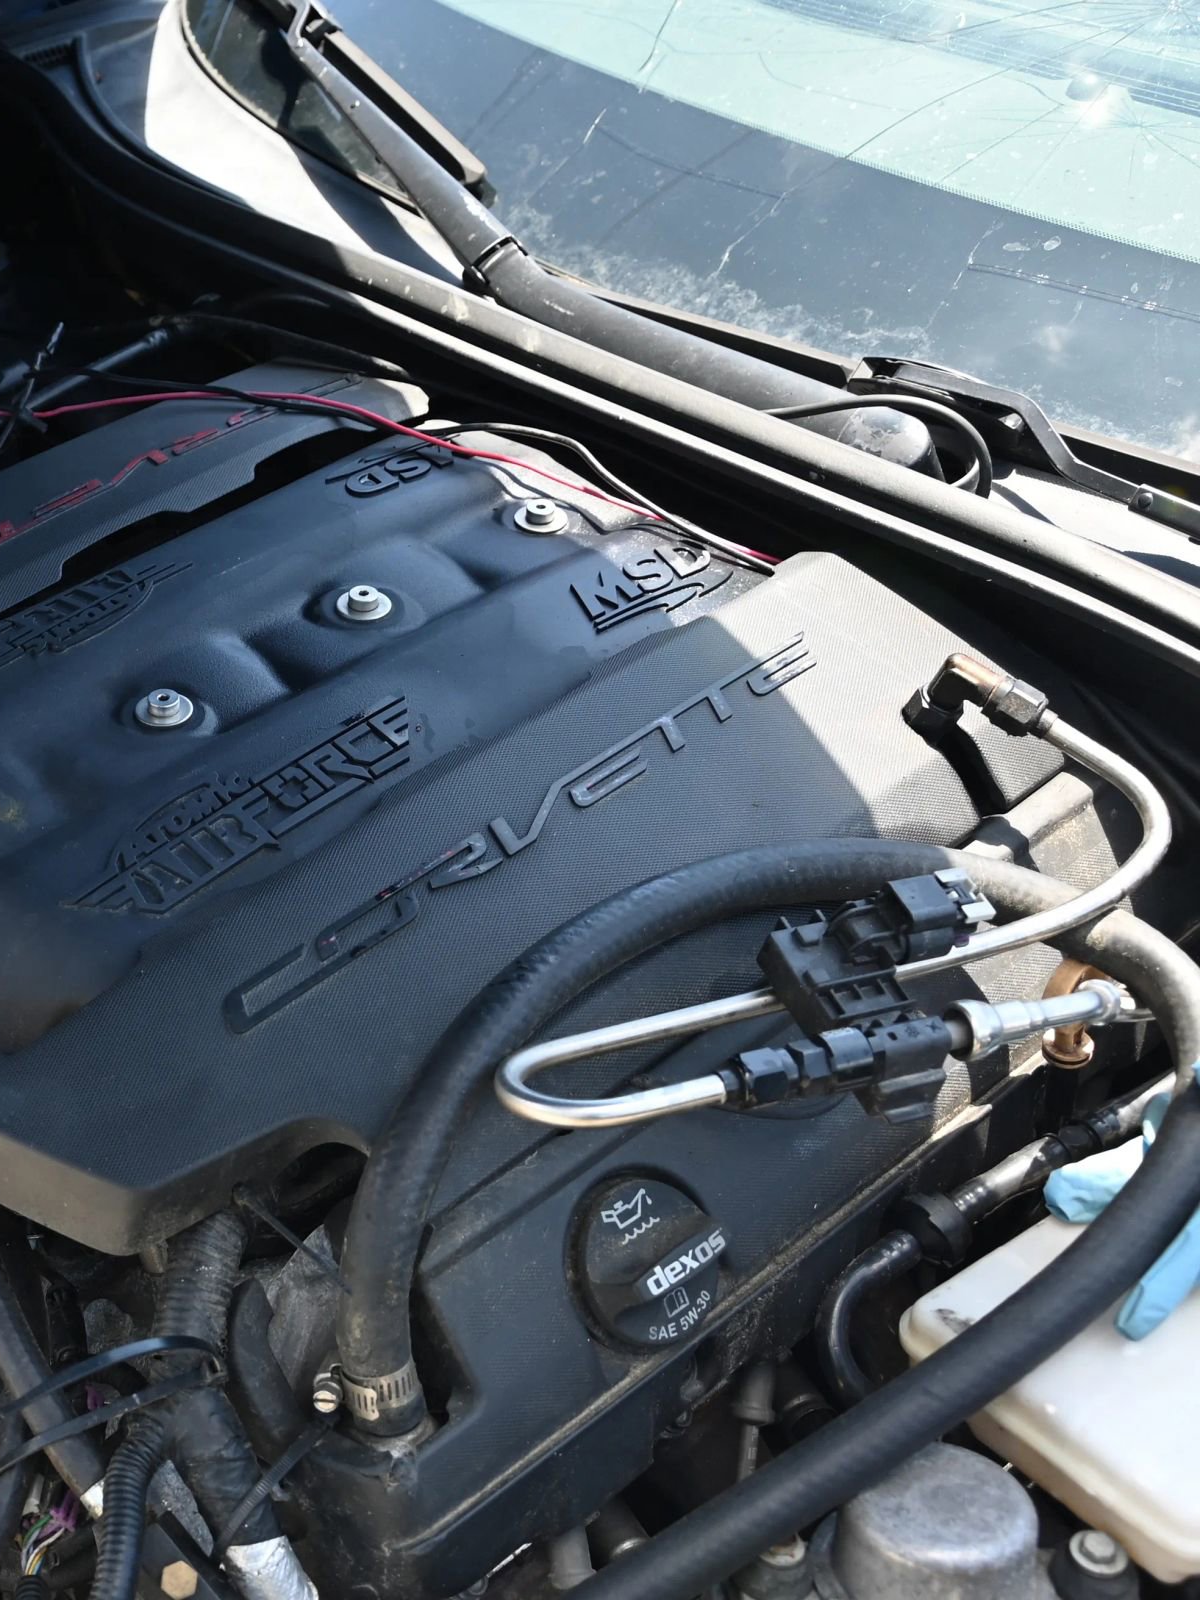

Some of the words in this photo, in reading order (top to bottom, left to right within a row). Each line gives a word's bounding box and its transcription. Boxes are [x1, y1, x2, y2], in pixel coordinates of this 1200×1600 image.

[569, 545, 711, 622] MSD
[222, 631, 817, 1034] CORVETTE
[646, 1232, 726, 1296] dexos
[649, 1323, 678, 1341] SAE
[680, 1290, 711, 1331] 5W-30
